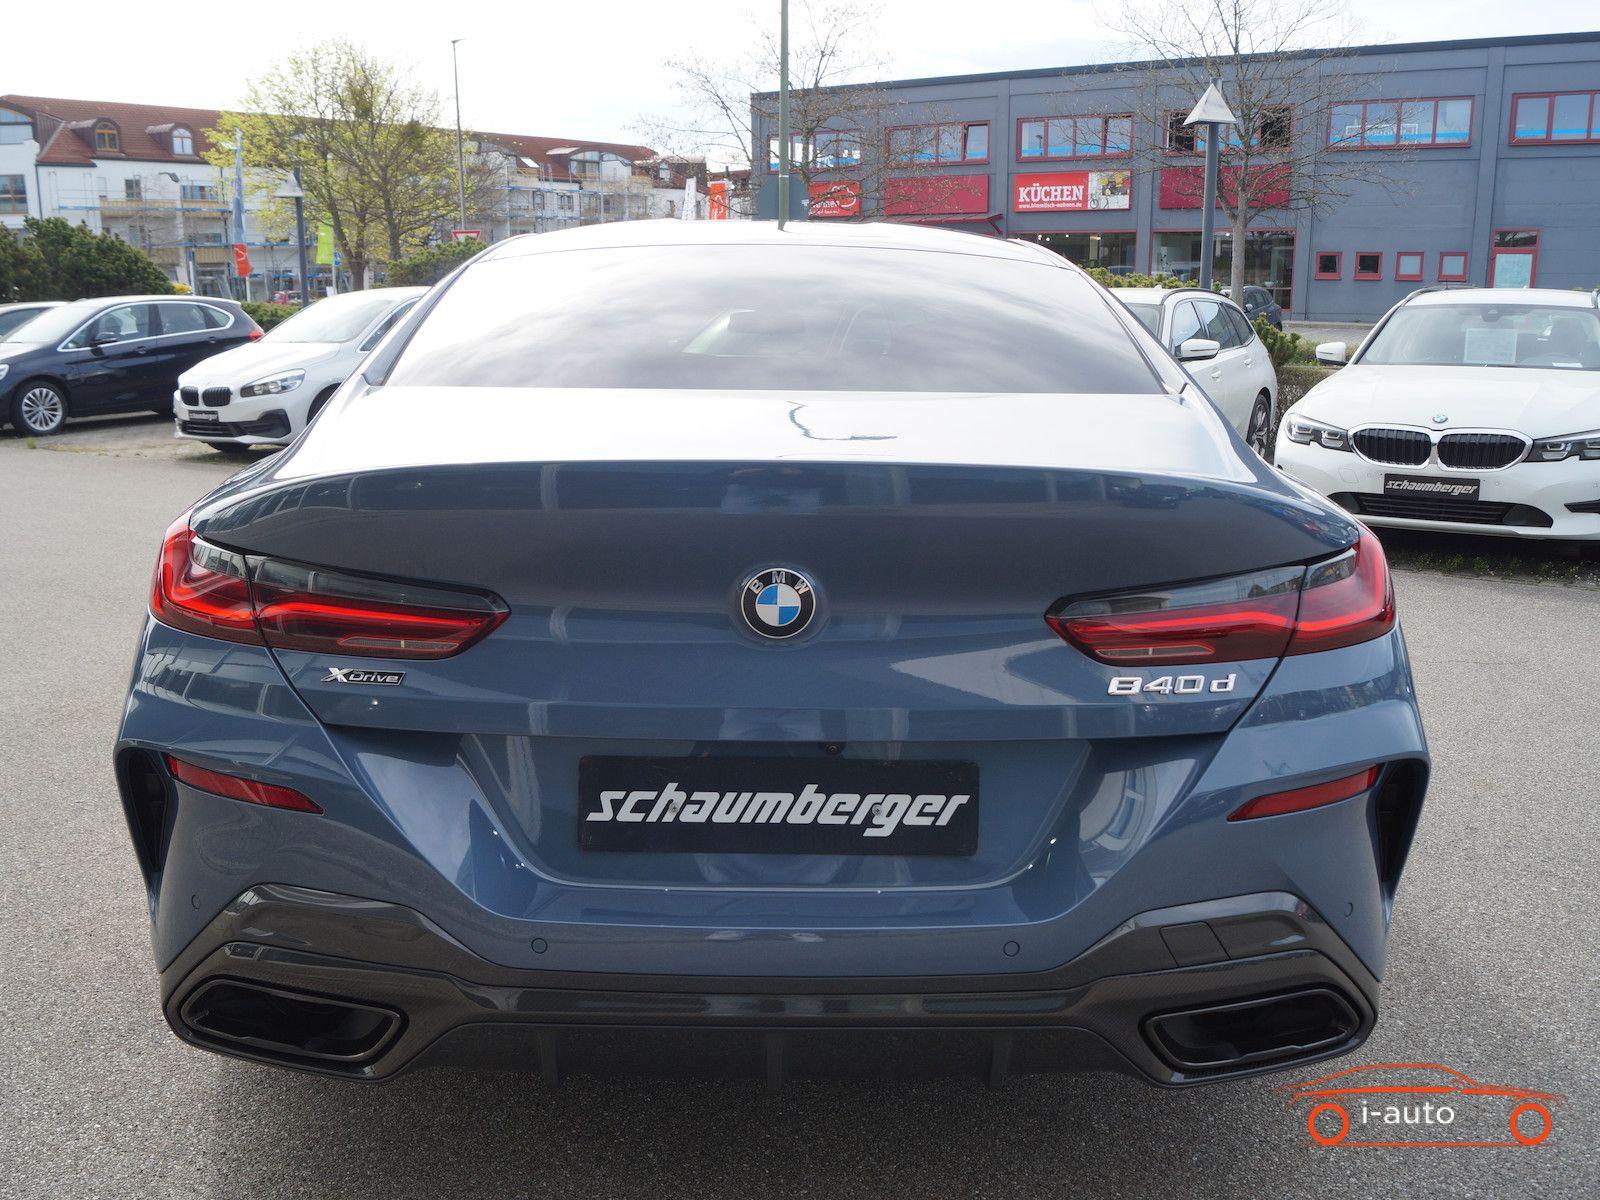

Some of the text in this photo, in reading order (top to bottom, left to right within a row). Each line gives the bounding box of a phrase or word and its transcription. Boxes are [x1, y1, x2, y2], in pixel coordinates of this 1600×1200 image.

[1018, 183, 1084, 202] KÜCHEN
[1385, 480, 1478, 496] schaumberger
[748, 571, 810, 594] BMW
[1107, 673, 1237, 696] 840d
[585, 782, 971, 837] schaumberger
